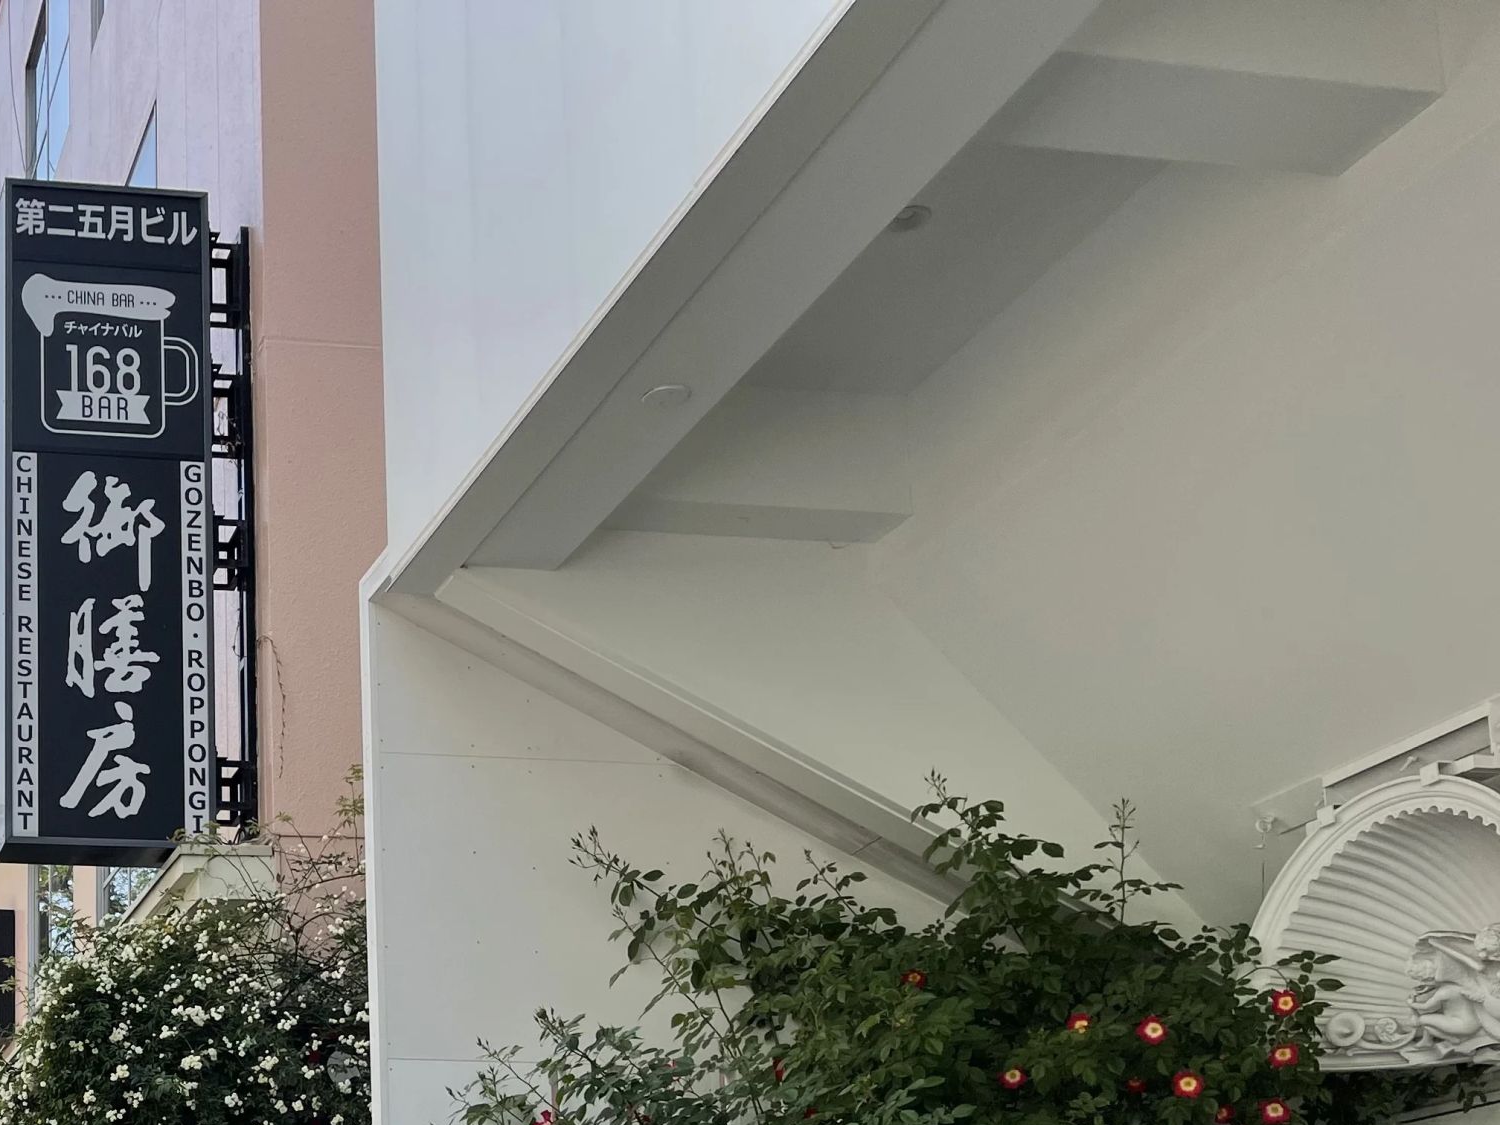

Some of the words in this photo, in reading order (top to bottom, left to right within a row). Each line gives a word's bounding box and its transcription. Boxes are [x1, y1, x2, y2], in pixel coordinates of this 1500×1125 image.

[15, 198, 198, 246] 第二五月ビル
[67, 290, 105, 306] CHINA
[111, 293, 135, 308] BAR
[64, 320, 142, 338] チャイナバル
[65, 344, 141, 395] 168
[81, 395, 129, 421] BAR
[16, 456, 33, 602] CHINESE
[60, 471, 166, 819] 御膳房
[16, 616, 34, 831] RESTAURANT
